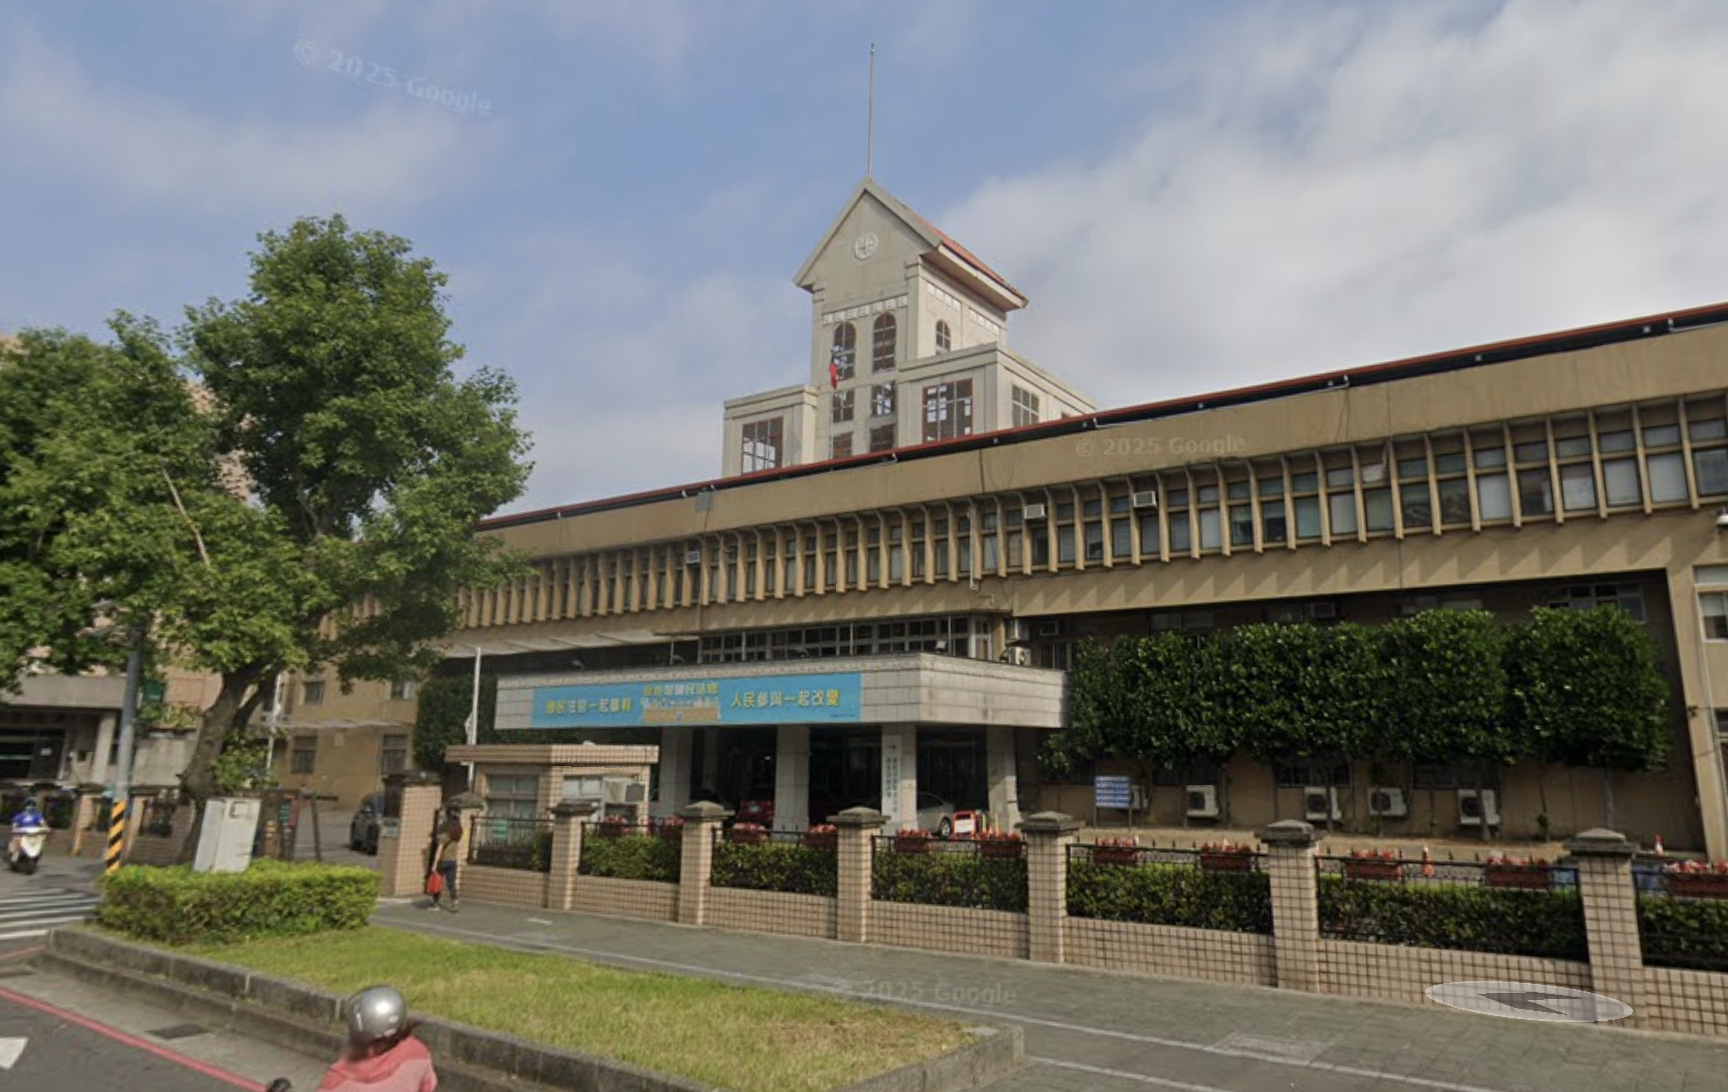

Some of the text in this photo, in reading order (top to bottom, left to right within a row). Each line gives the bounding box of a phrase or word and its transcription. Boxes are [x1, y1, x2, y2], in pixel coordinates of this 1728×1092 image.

[730, 689, 841, 709] 人民參與一起改變
